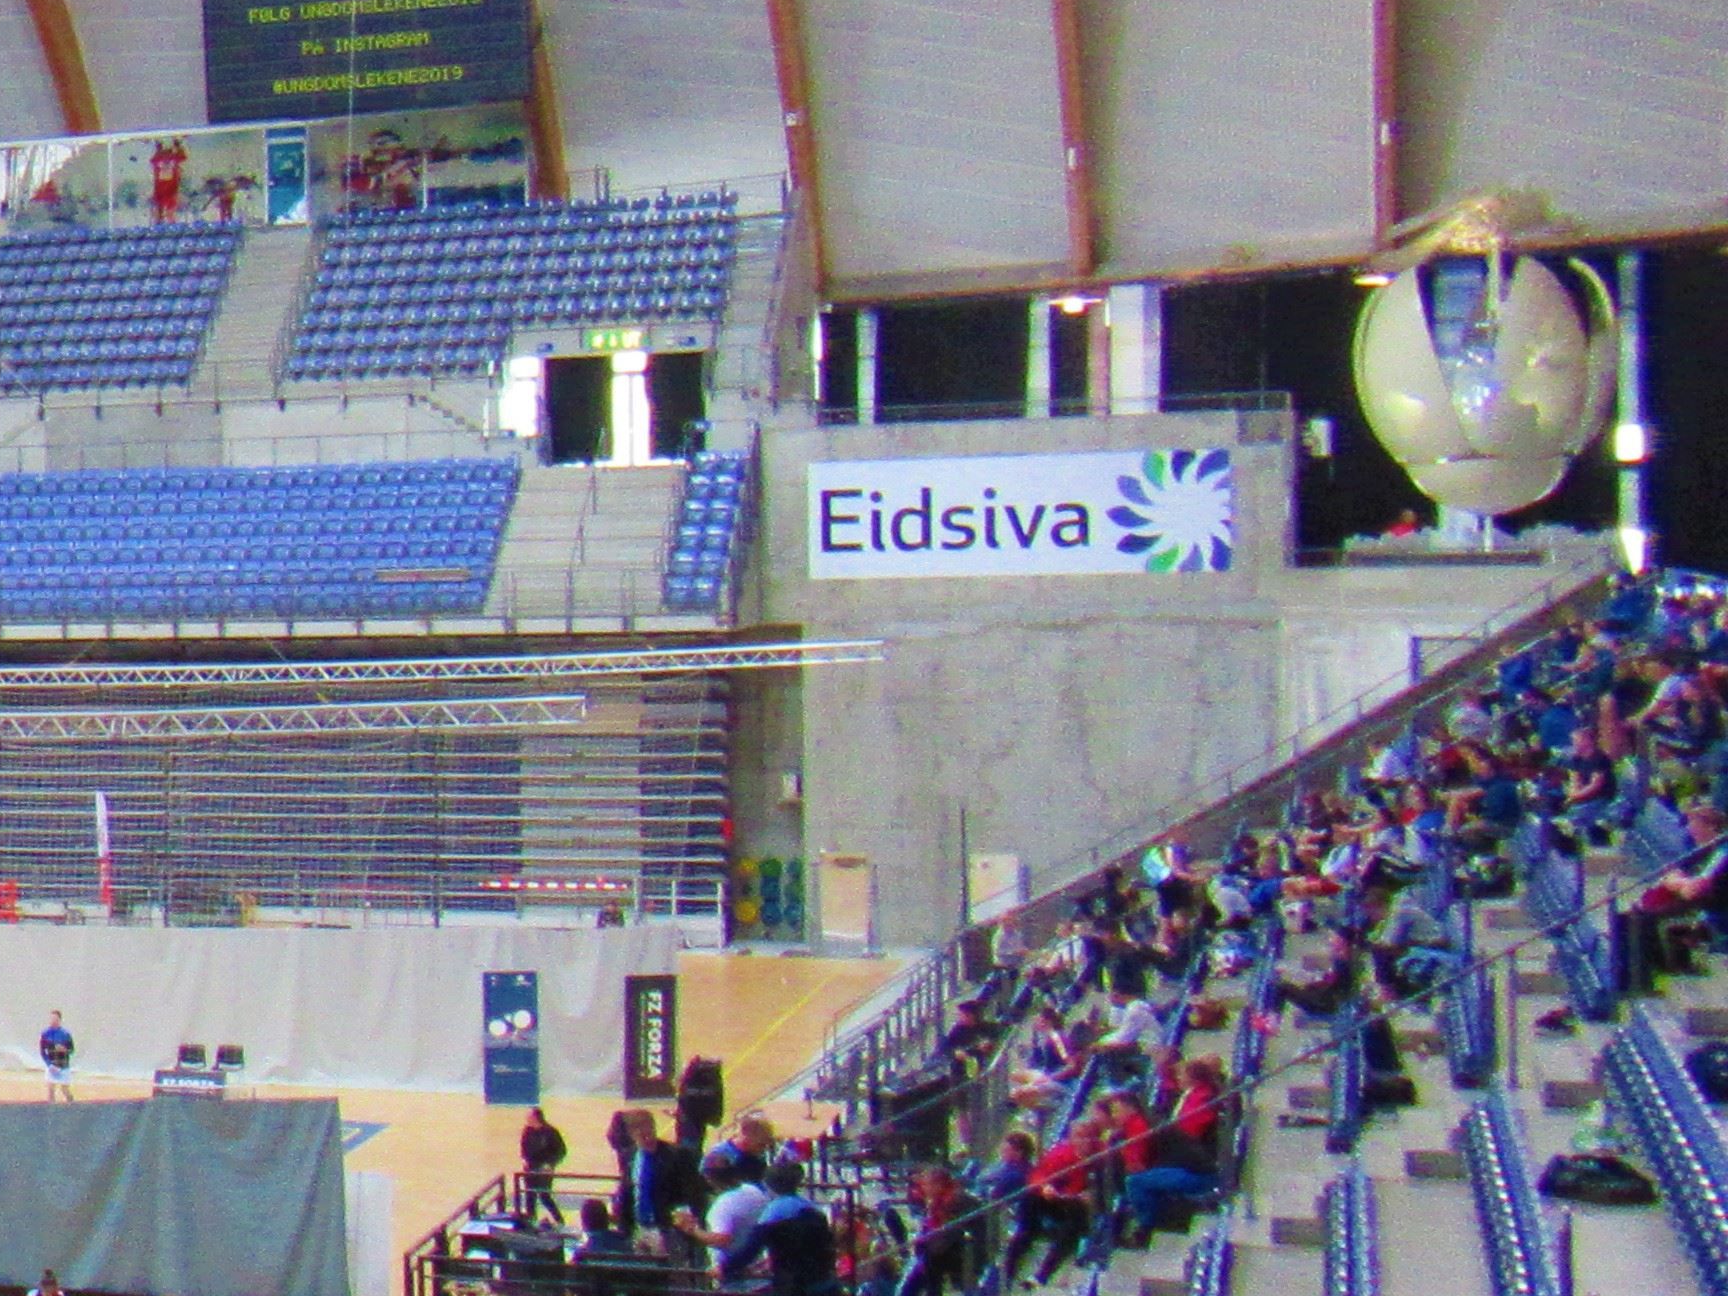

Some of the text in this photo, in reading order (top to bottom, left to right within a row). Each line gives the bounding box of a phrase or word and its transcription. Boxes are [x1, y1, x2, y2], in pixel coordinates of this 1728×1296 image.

[248, 6, 292, 24] FØLG
[334, 30, 431, 54] INSTAGRAM
[820, 486, 1091, 553] Eidsiva
[647, 990, 663, 1079] FZ FORZA
